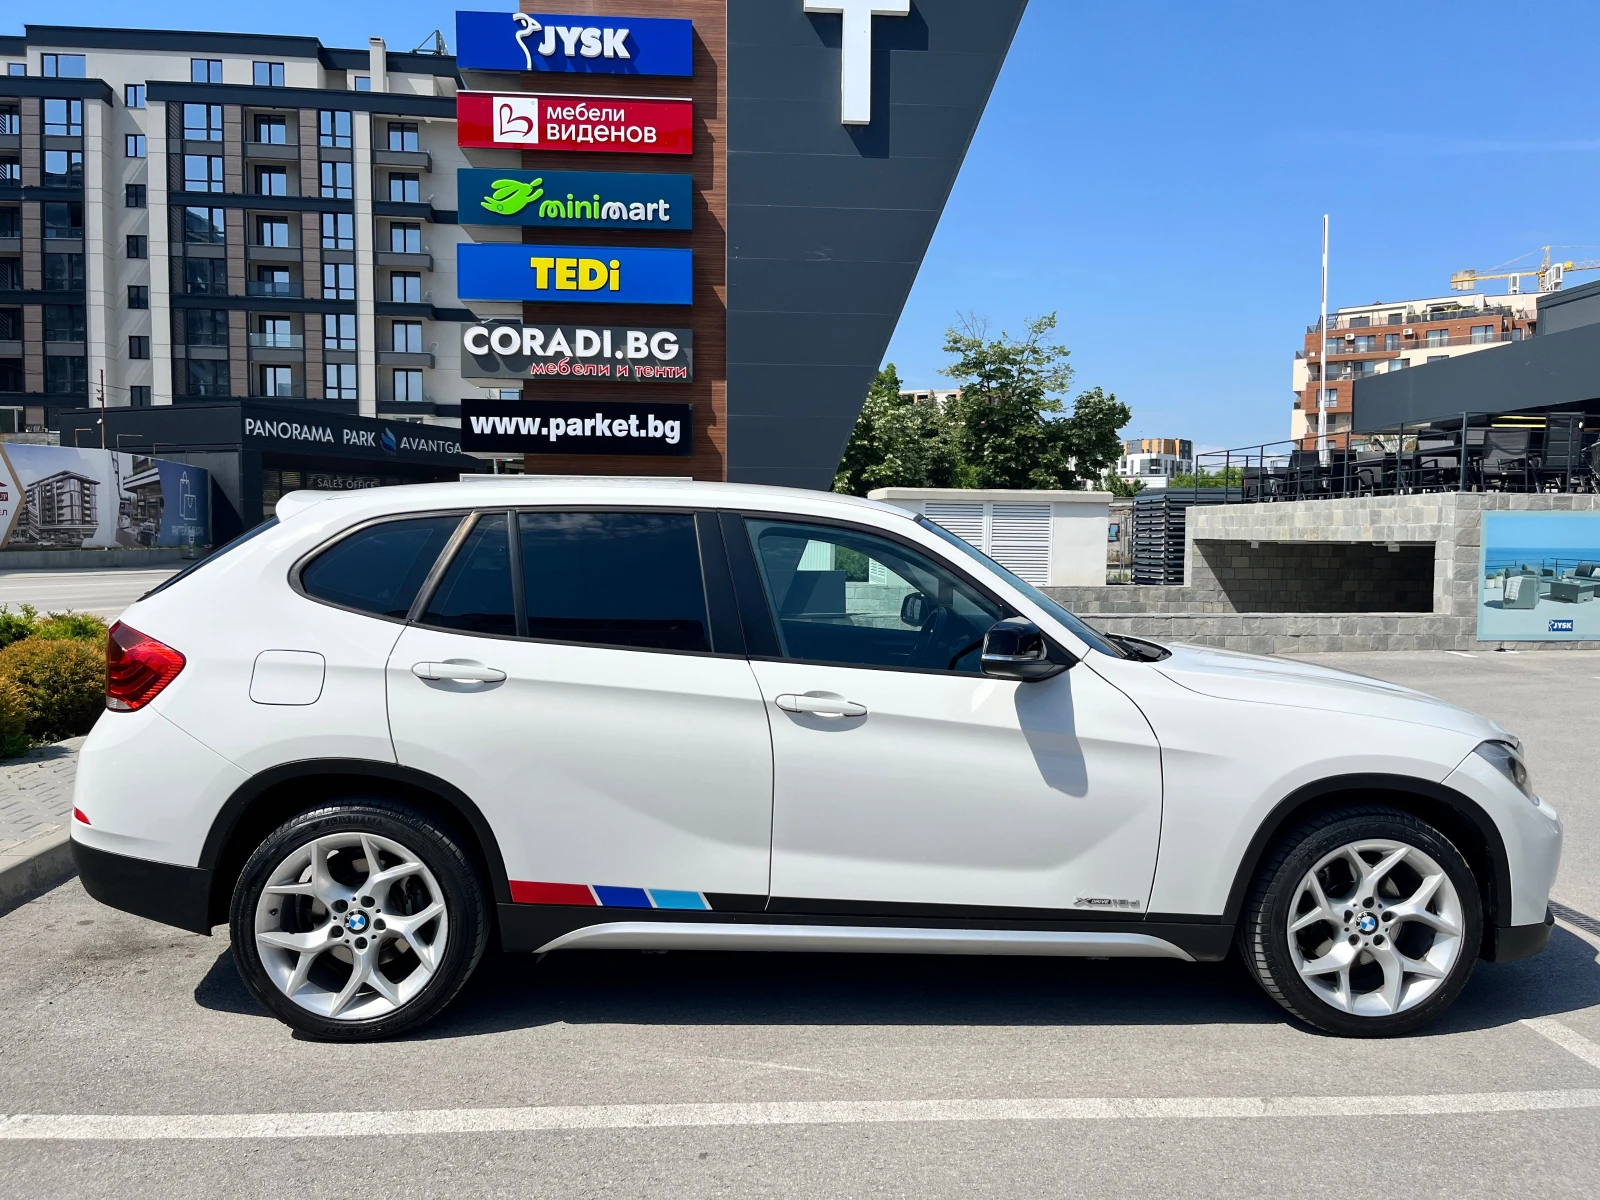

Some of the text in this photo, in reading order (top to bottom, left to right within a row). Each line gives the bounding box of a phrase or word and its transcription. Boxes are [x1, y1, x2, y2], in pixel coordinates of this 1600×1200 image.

[537, 25, 631, 59] JYSK
[546, 102, 625, 122] мебели
[538, 193, 671, 222] minimart
[530, 256, 621, 291] TEDi
[463, 326, 679, 361] CORADI.BG
[530, 357, 687, 378] мебели и тенти
[244, 418, 334, 443] PANORAMA
[343, 428, 376, 447] PARK
[470, 413, 681, 445] www.parket.bg
[317, 478, 375, 489] SALES OFFICE
